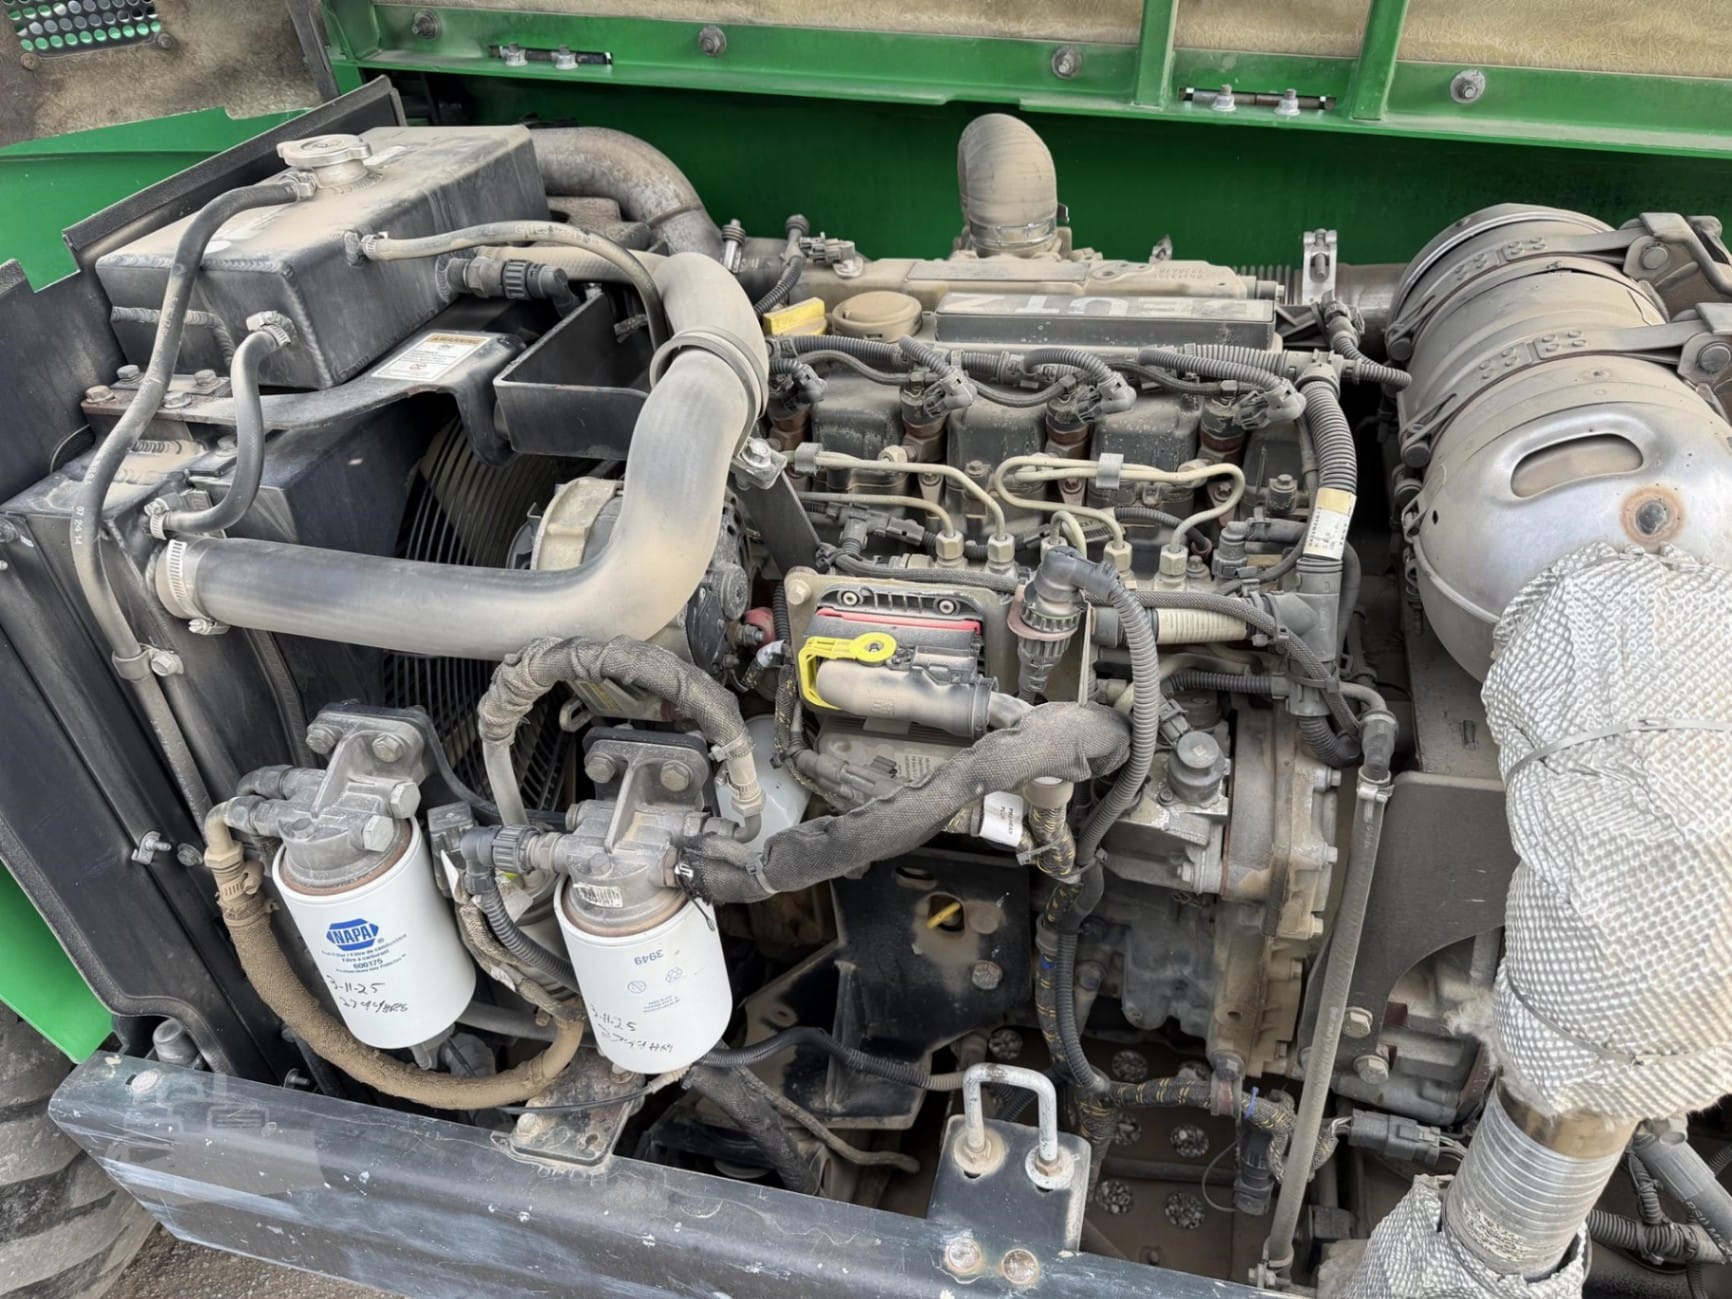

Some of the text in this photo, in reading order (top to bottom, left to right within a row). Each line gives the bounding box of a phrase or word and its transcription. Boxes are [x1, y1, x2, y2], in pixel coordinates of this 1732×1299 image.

[942, 293, 1268, 322] DEUTZ
[332, 925, 372, 945] NAPA
[634, 949, 664, 966] 3949
